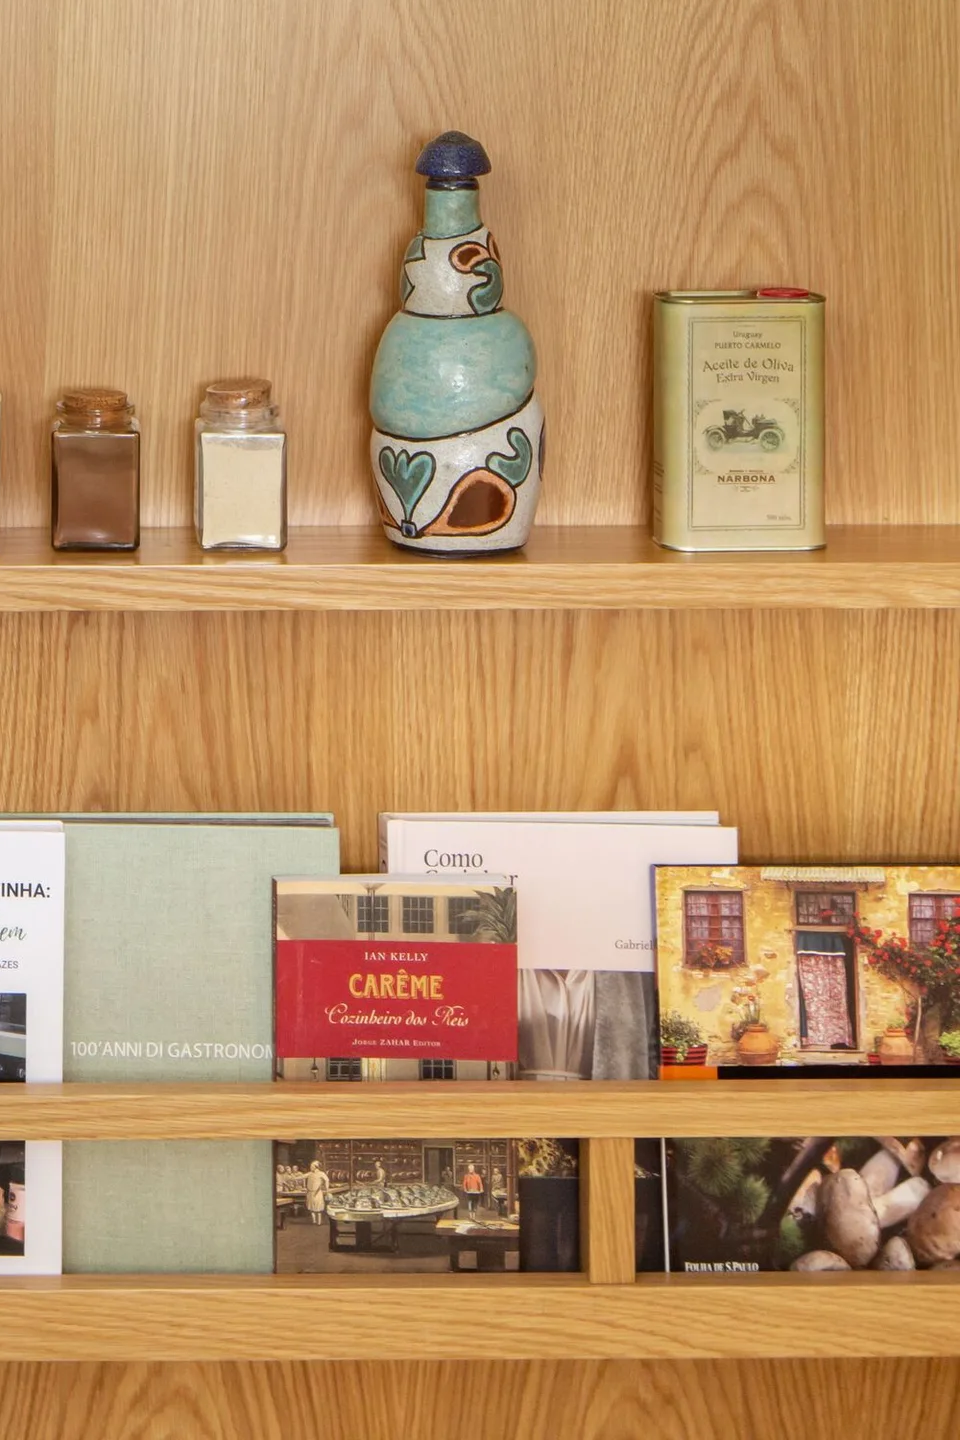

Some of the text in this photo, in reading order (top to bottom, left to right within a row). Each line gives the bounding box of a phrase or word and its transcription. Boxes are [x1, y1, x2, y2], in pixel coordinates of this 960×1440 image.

[714, 341, 782, 350] PUERTO CARMELO
[702, 357, 795, 373] Aceite de Oliva
[715, 371, 780, 385] Extra Virgen
[717, 474, 777, 483] NARBONA
[423, 848, 483, 868] Como
[364, 951, 429, 962] IAN KELLY
[348, 968, 445, 1001] CARÊME
[324, 1002, 470, 1027] Cozinheiro dos Reis
[146, 1042, 163, 1058] DI
[379, 1038, 411, 1047] ZAHAR
